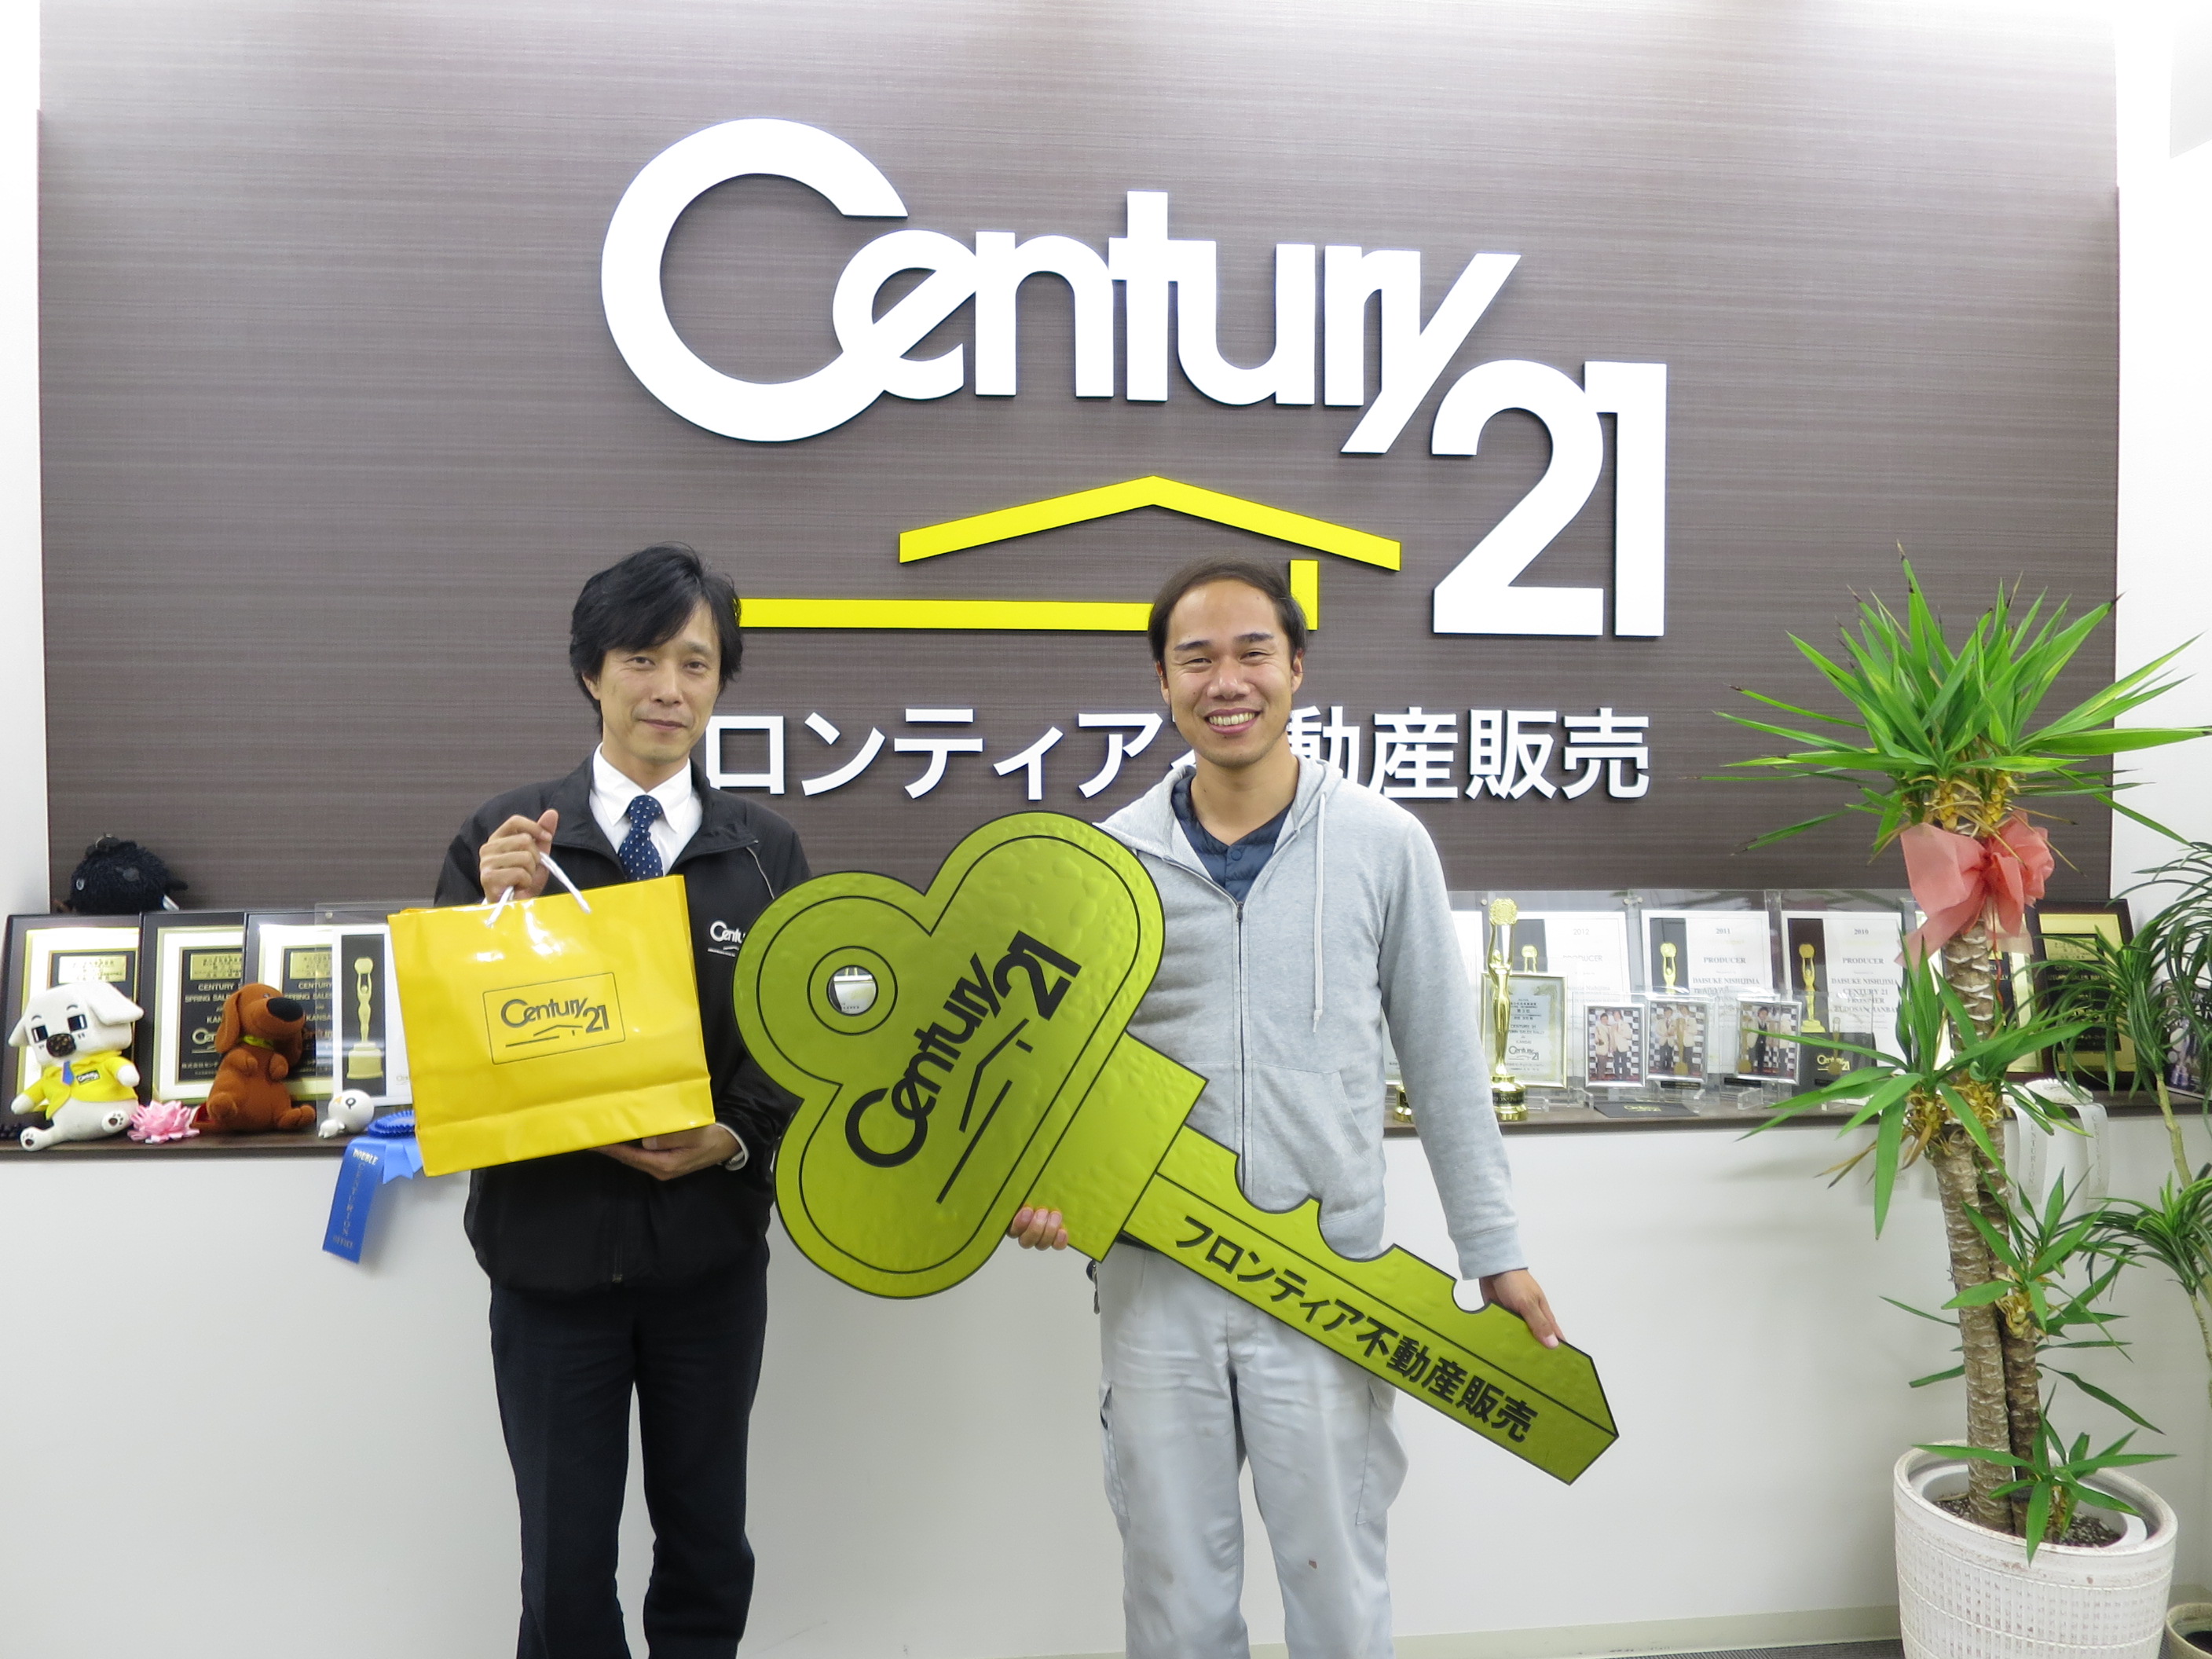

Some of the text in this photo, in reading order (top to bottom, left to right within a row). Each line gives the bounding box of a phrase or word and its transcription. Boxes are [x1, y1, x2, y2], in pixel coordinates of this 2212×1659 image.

[602, 117, 1667, 638] Century 21
[709, 920, 746, 944] Centu
[198, 983, 235, 991] CENTURY
[500, 997, 610, 1034] Century 21
[844, 930, 1082, 1169] Century 21
[1508, 1046, 1540, 1060] Century 21
[1175, 1215, 1539, 1443] フロンティア不動産販売
